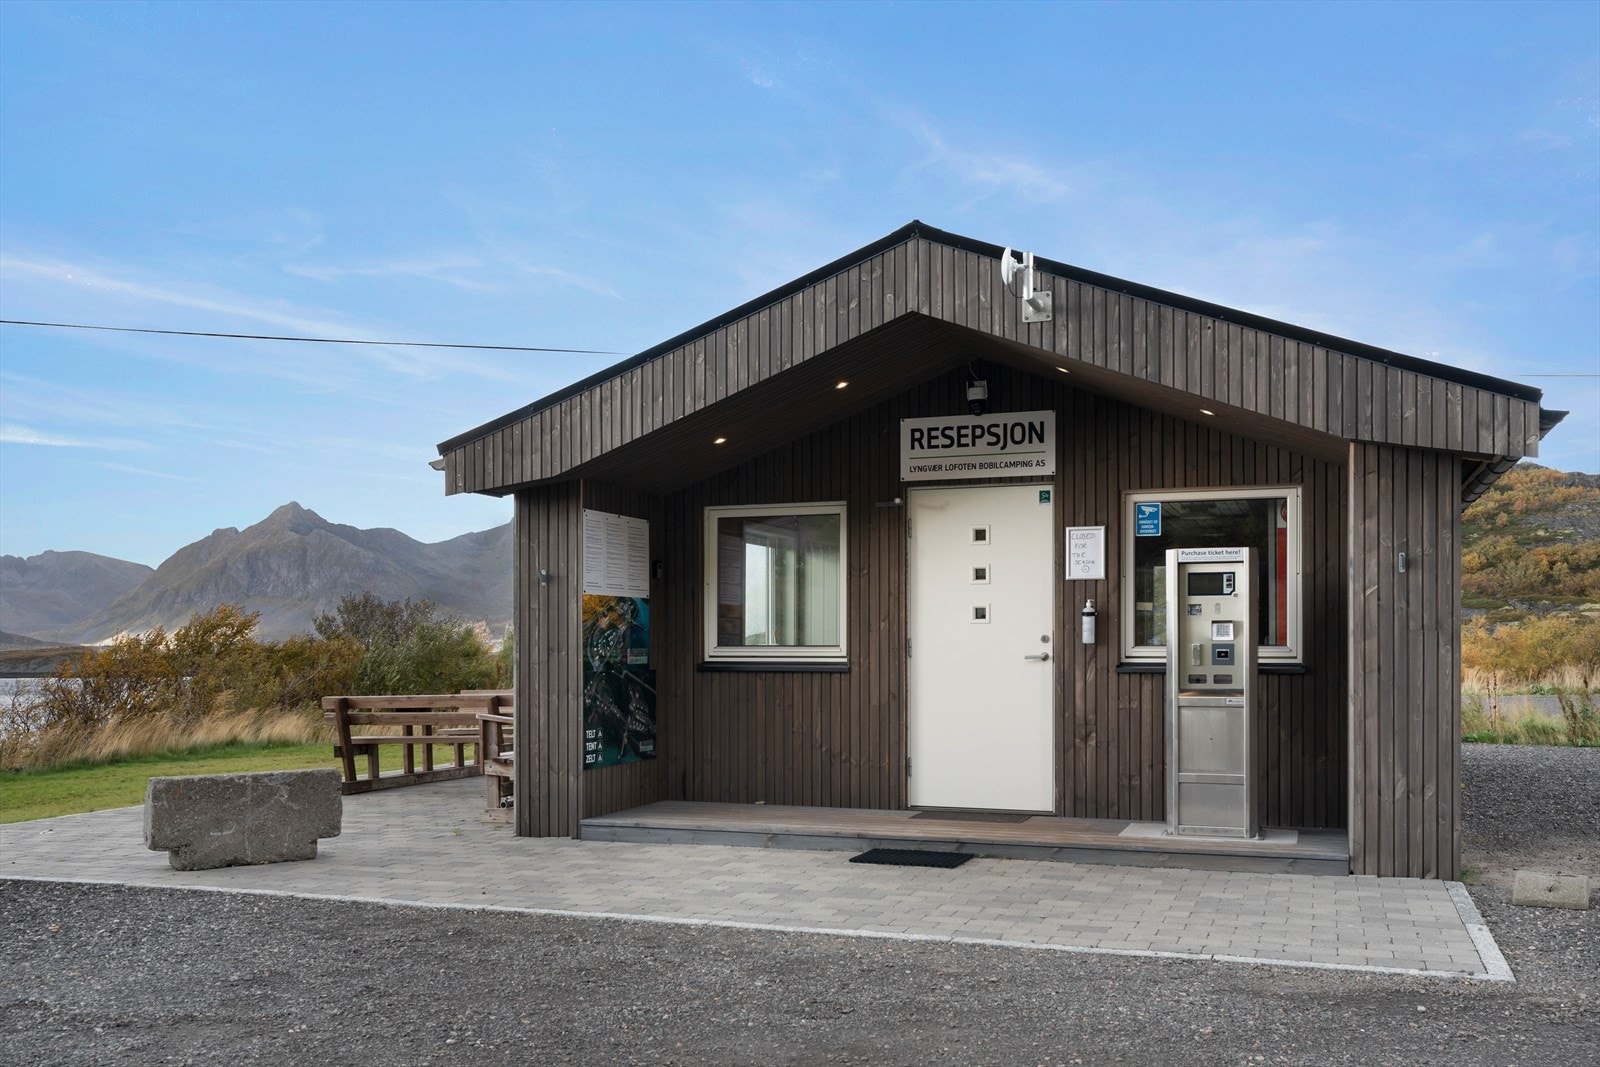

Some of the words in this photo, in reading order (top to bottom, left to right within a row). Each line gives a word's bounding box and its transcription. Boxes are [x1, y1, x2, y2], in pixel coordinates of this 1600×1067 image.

[911, 420, 1045, 450] RESEPSJON
[909, 463, 943, 473] LYNGVÆR
[945, 462, 977, 472] LOFOTEN
[979, 460, 1033, 470] BOBILCAMPING
[1035, 459, 1046, 467] AS
[1071, 532, 1096, 540] CLOSED
[586, 729, 596, 739] TELT
[586, 741, 598, 751] TENT
[586, 753, 596, 764] ZELT
